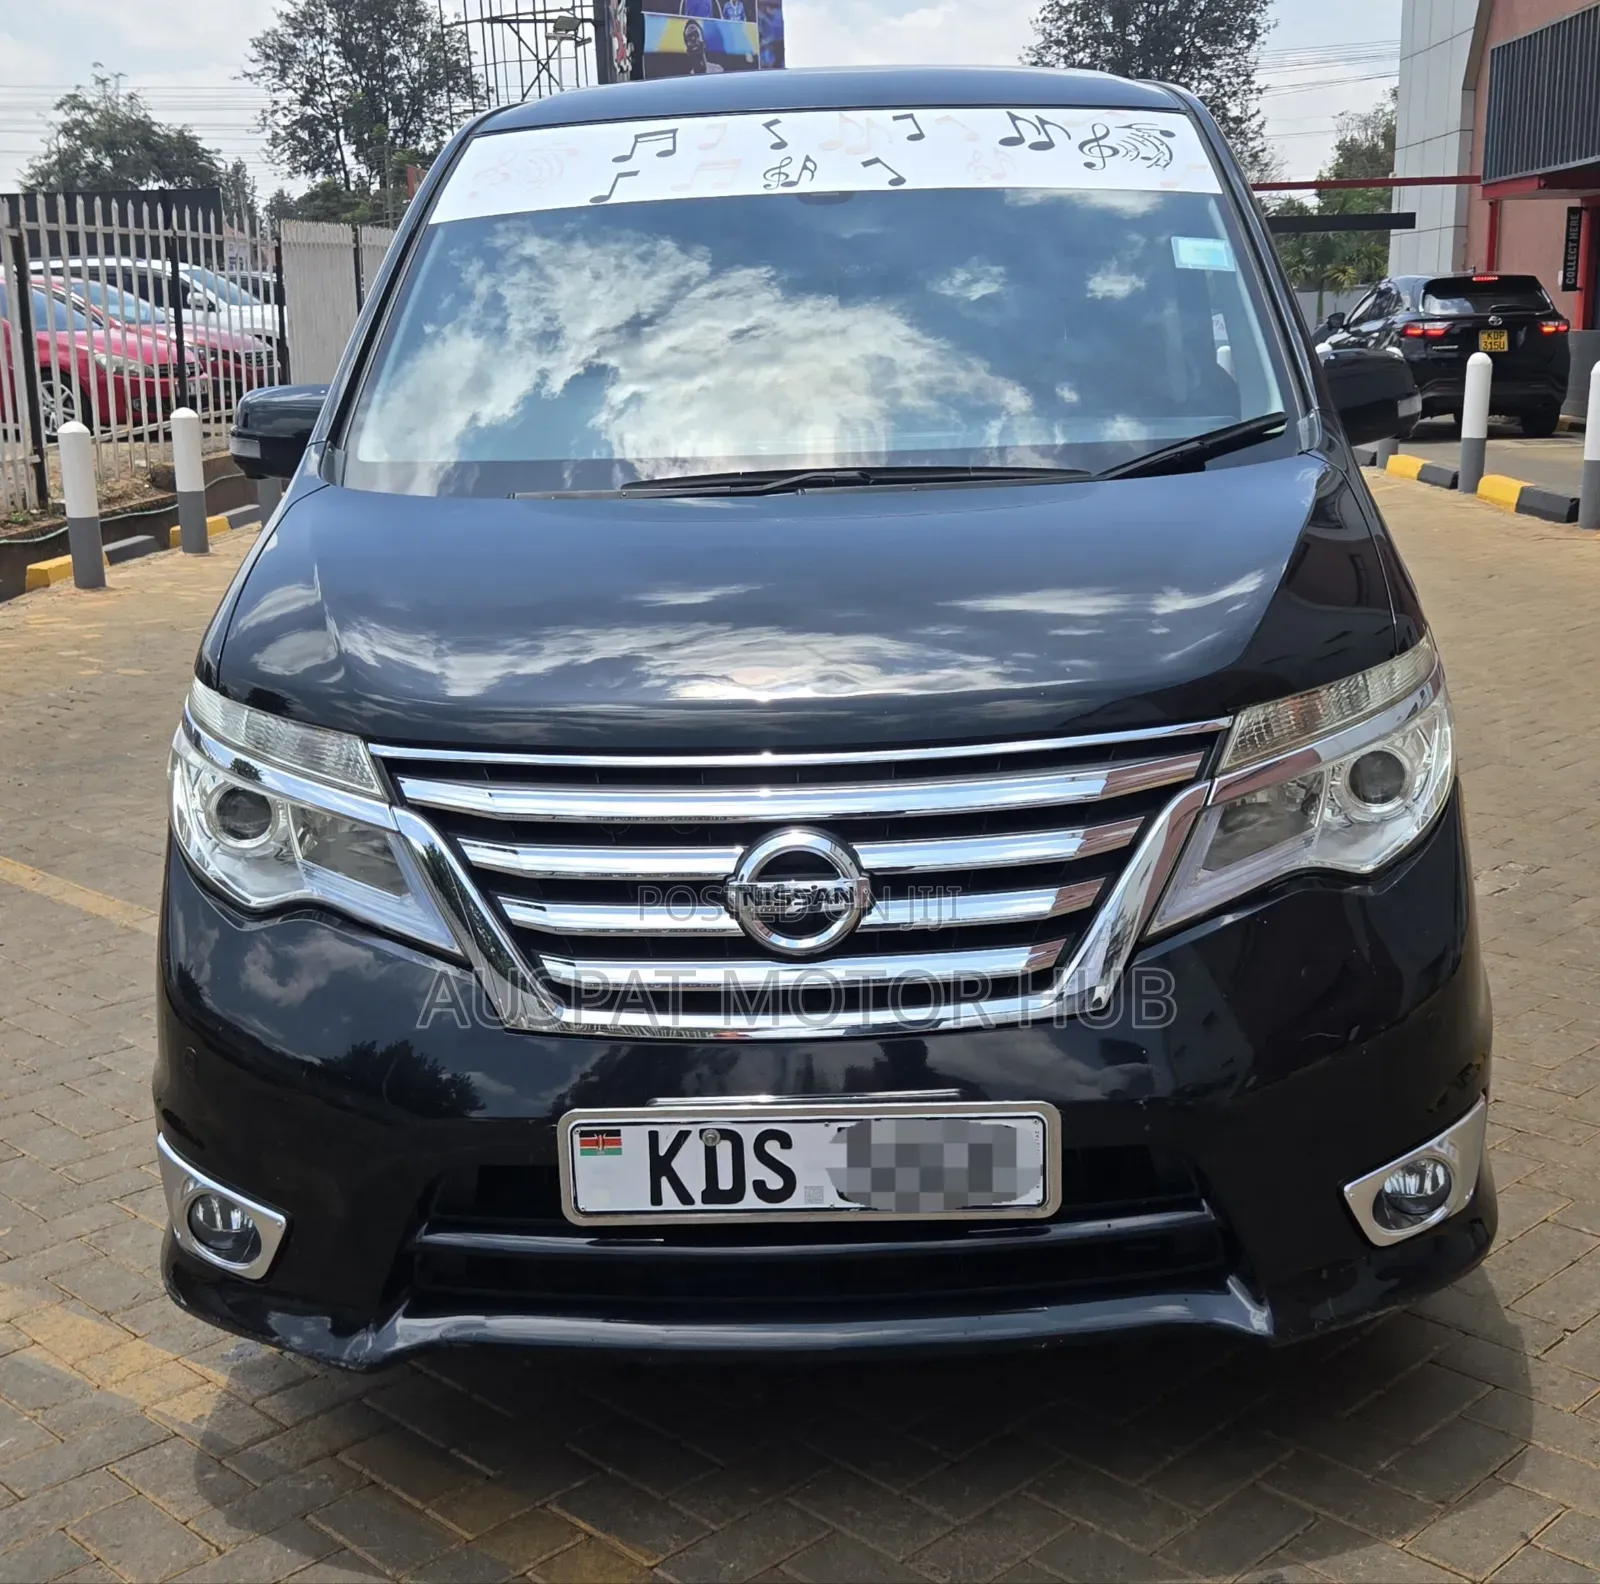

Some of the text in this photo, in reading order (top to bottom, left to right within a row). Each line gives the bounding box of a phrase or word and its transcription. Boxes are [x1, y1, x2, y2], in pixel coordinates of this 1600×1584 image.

[1566, 213, 1580, 285] COLLECT HERE
[1482, 341, 1505, 350] 315U
[1486, 331, 1505, 340] KDP
[742, 884, 855, 907] NISSAN
[647, 1128, 798, 1207] KDS
